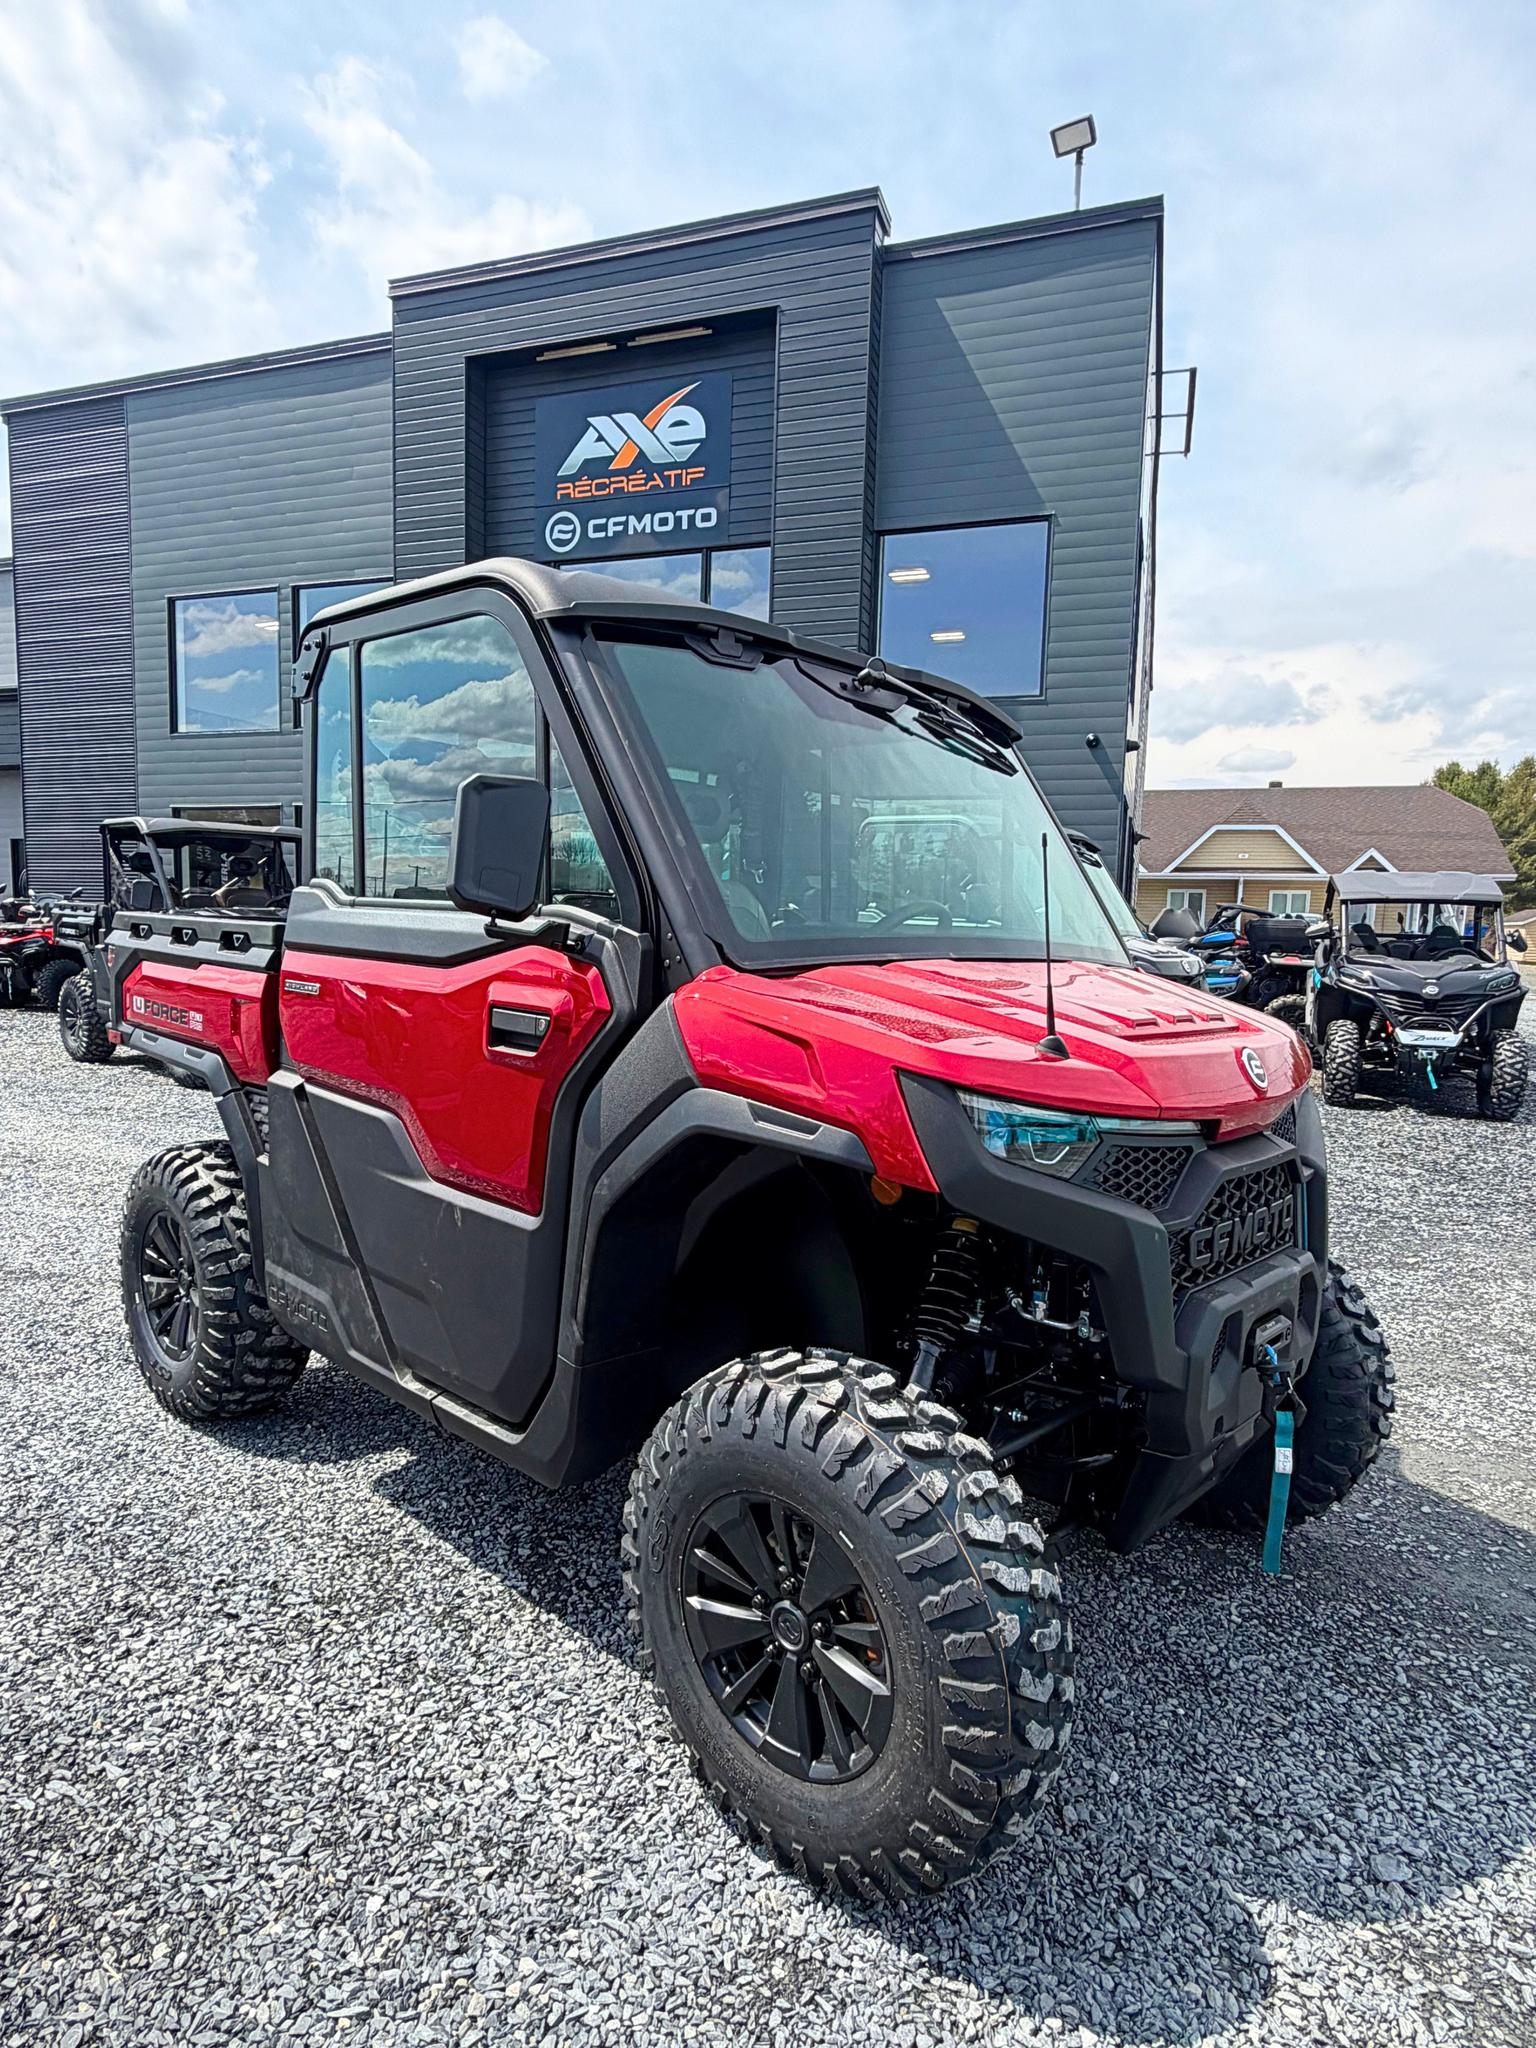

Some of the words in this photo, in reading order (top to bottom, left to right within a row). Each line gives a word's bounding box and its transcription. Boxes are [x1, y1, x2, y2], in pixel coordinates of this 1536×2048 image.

[556, 466, 706, 500] RÉCRÉATIF
[587, 507, 718, 539] CFMOTO
[1189, 1194, 1294, 1269] CFMOTO
